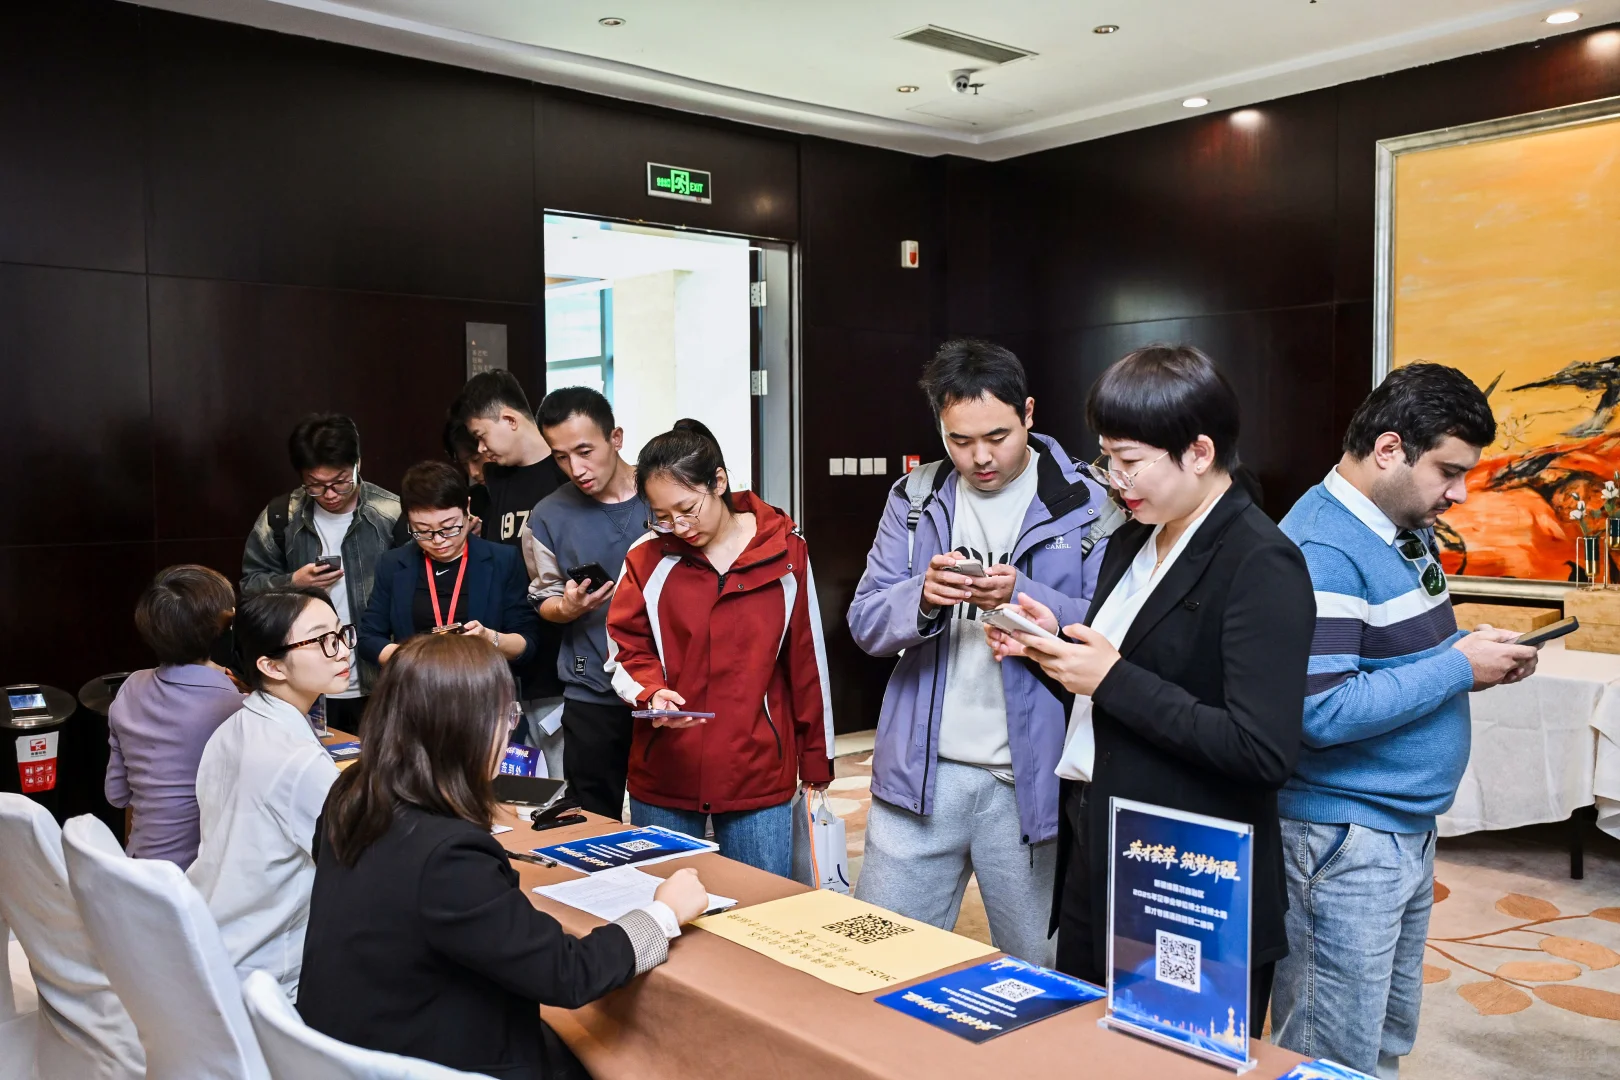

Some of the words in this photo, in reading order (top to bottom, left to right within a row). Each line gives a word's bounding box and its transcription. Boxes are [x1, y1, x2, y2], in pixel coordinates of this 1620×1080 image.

[690, 182, 703, 193] EXIT
[1123, 839, 1178, 870] 英才荟萃
[1180, 851, 1241, 883] 筑梦新疆
